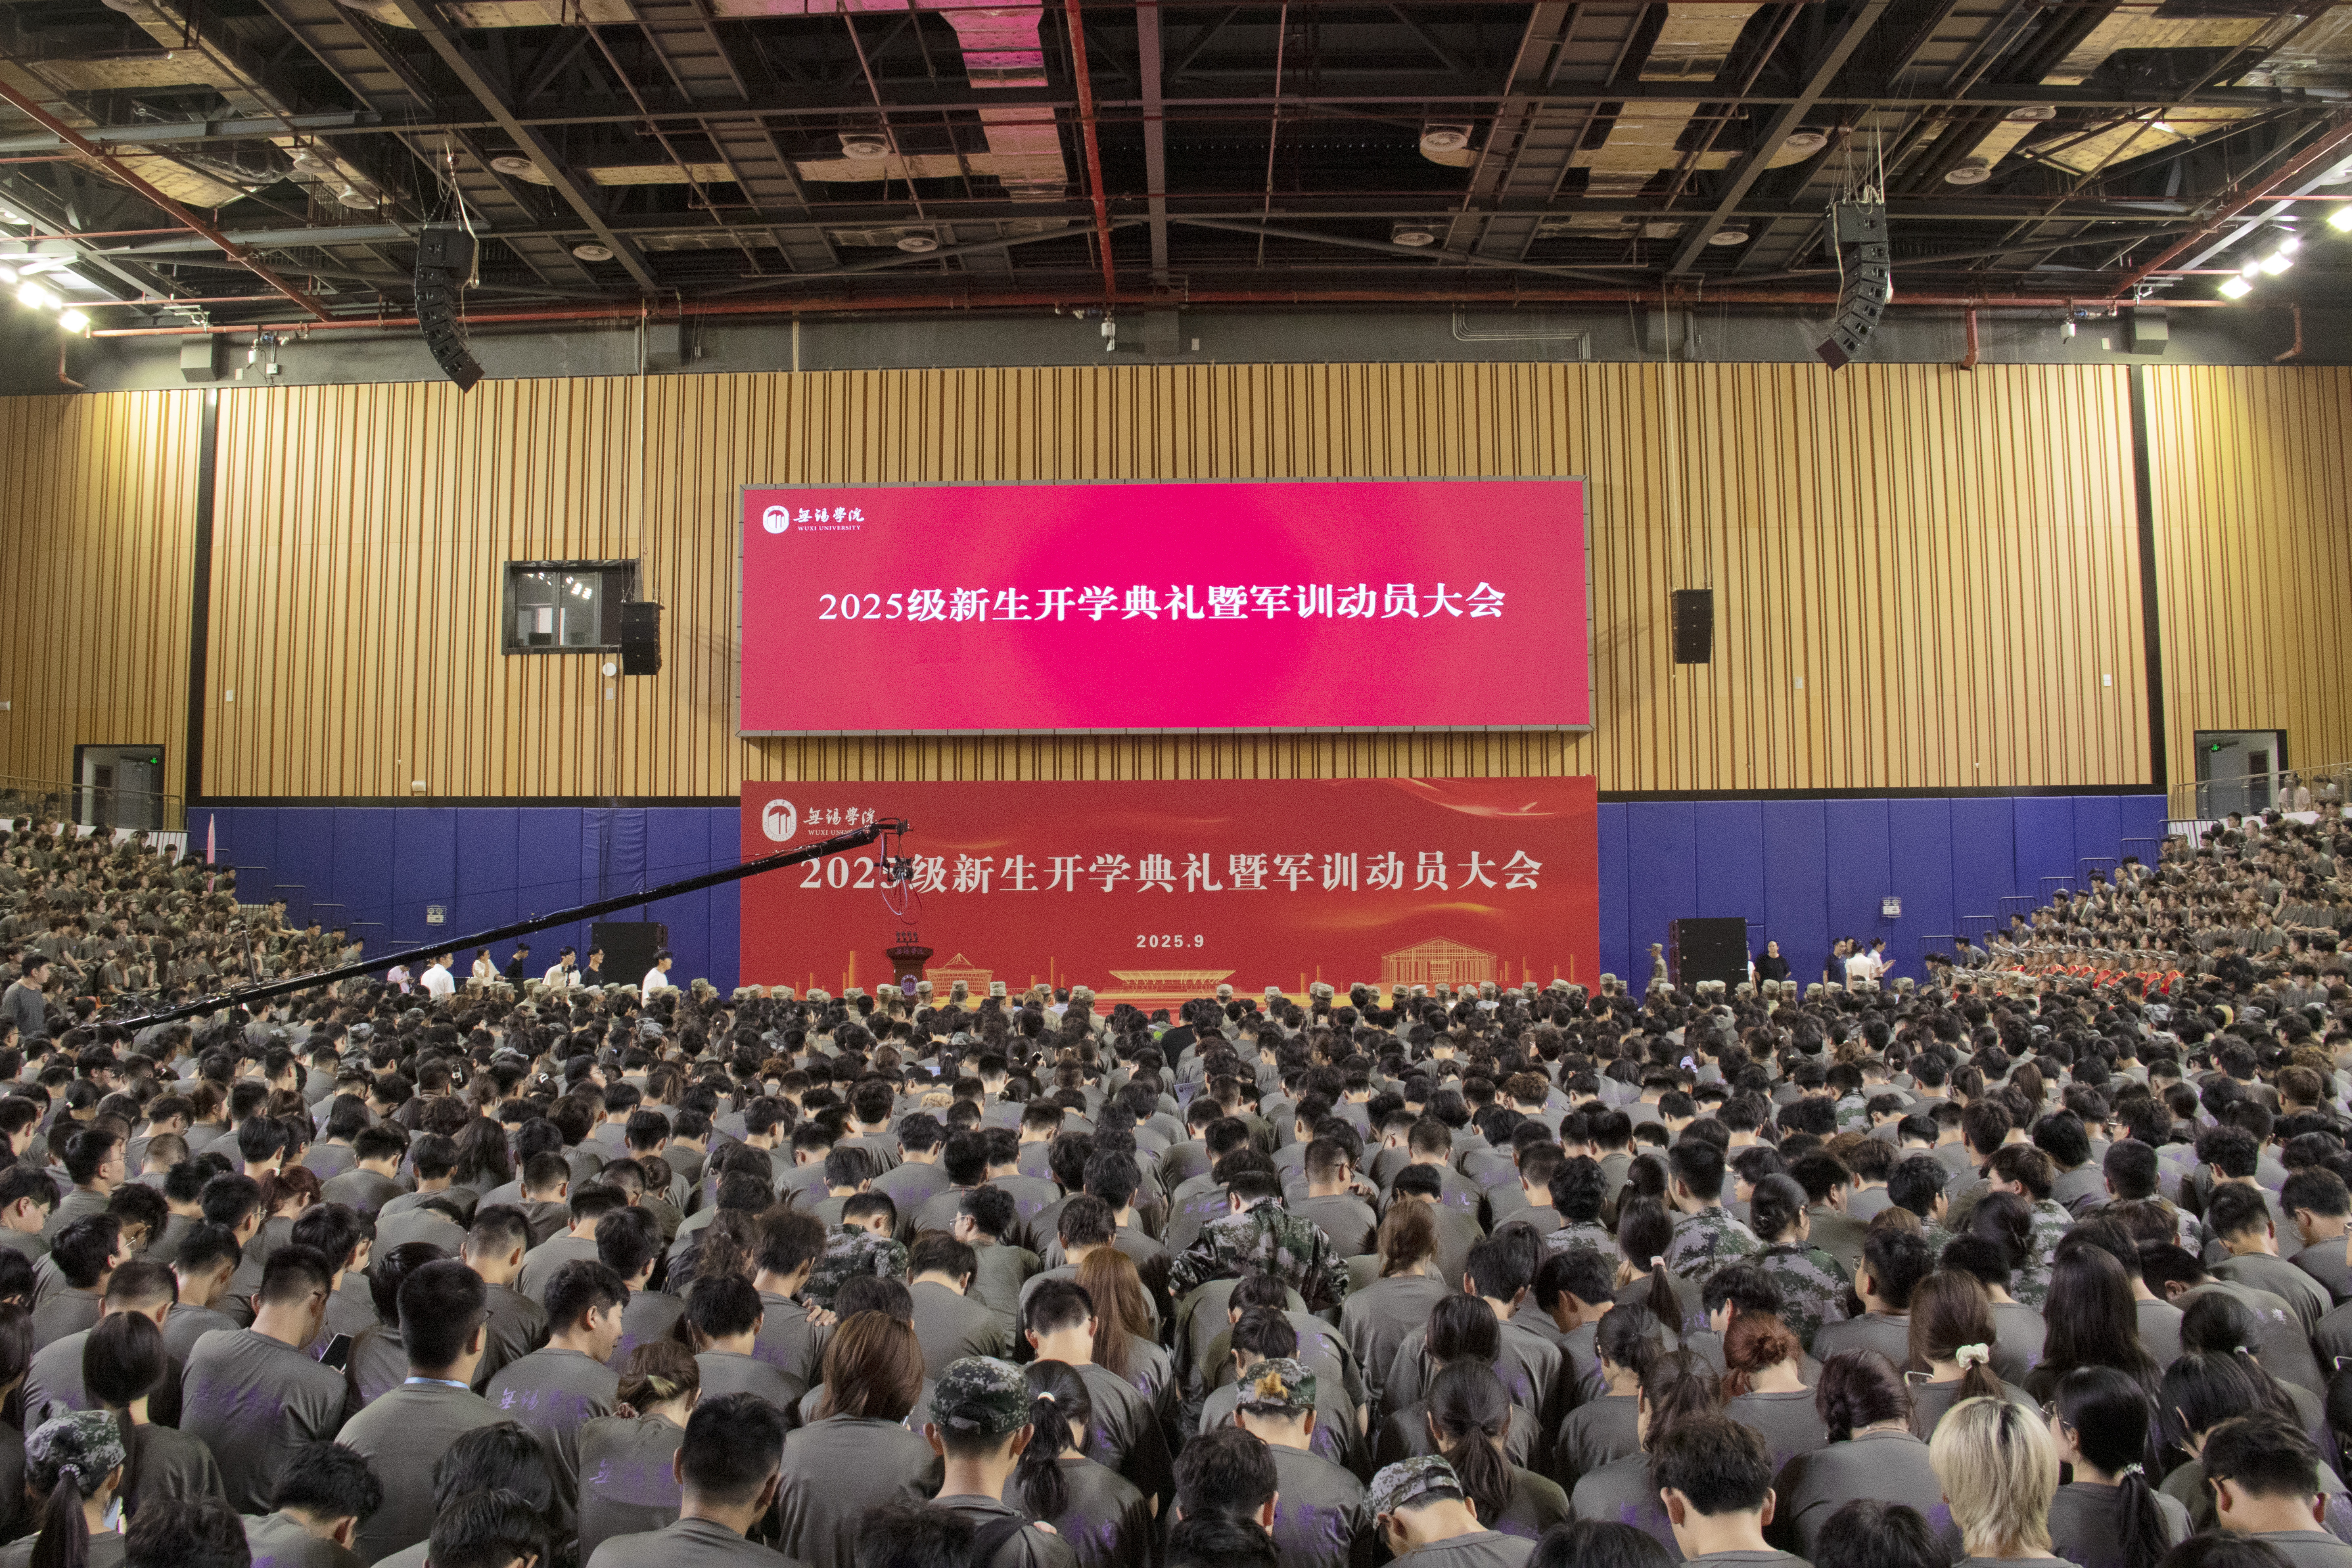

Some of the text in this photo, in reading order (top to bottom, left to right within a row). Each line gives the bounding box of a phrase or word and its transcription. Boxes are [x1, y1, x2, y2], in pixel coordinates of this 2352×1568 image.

[819, 582, 1506, 622] 2025级新生开学典礼暨军训动员大会
[1136, 934, 1204, 948] 2025.9
